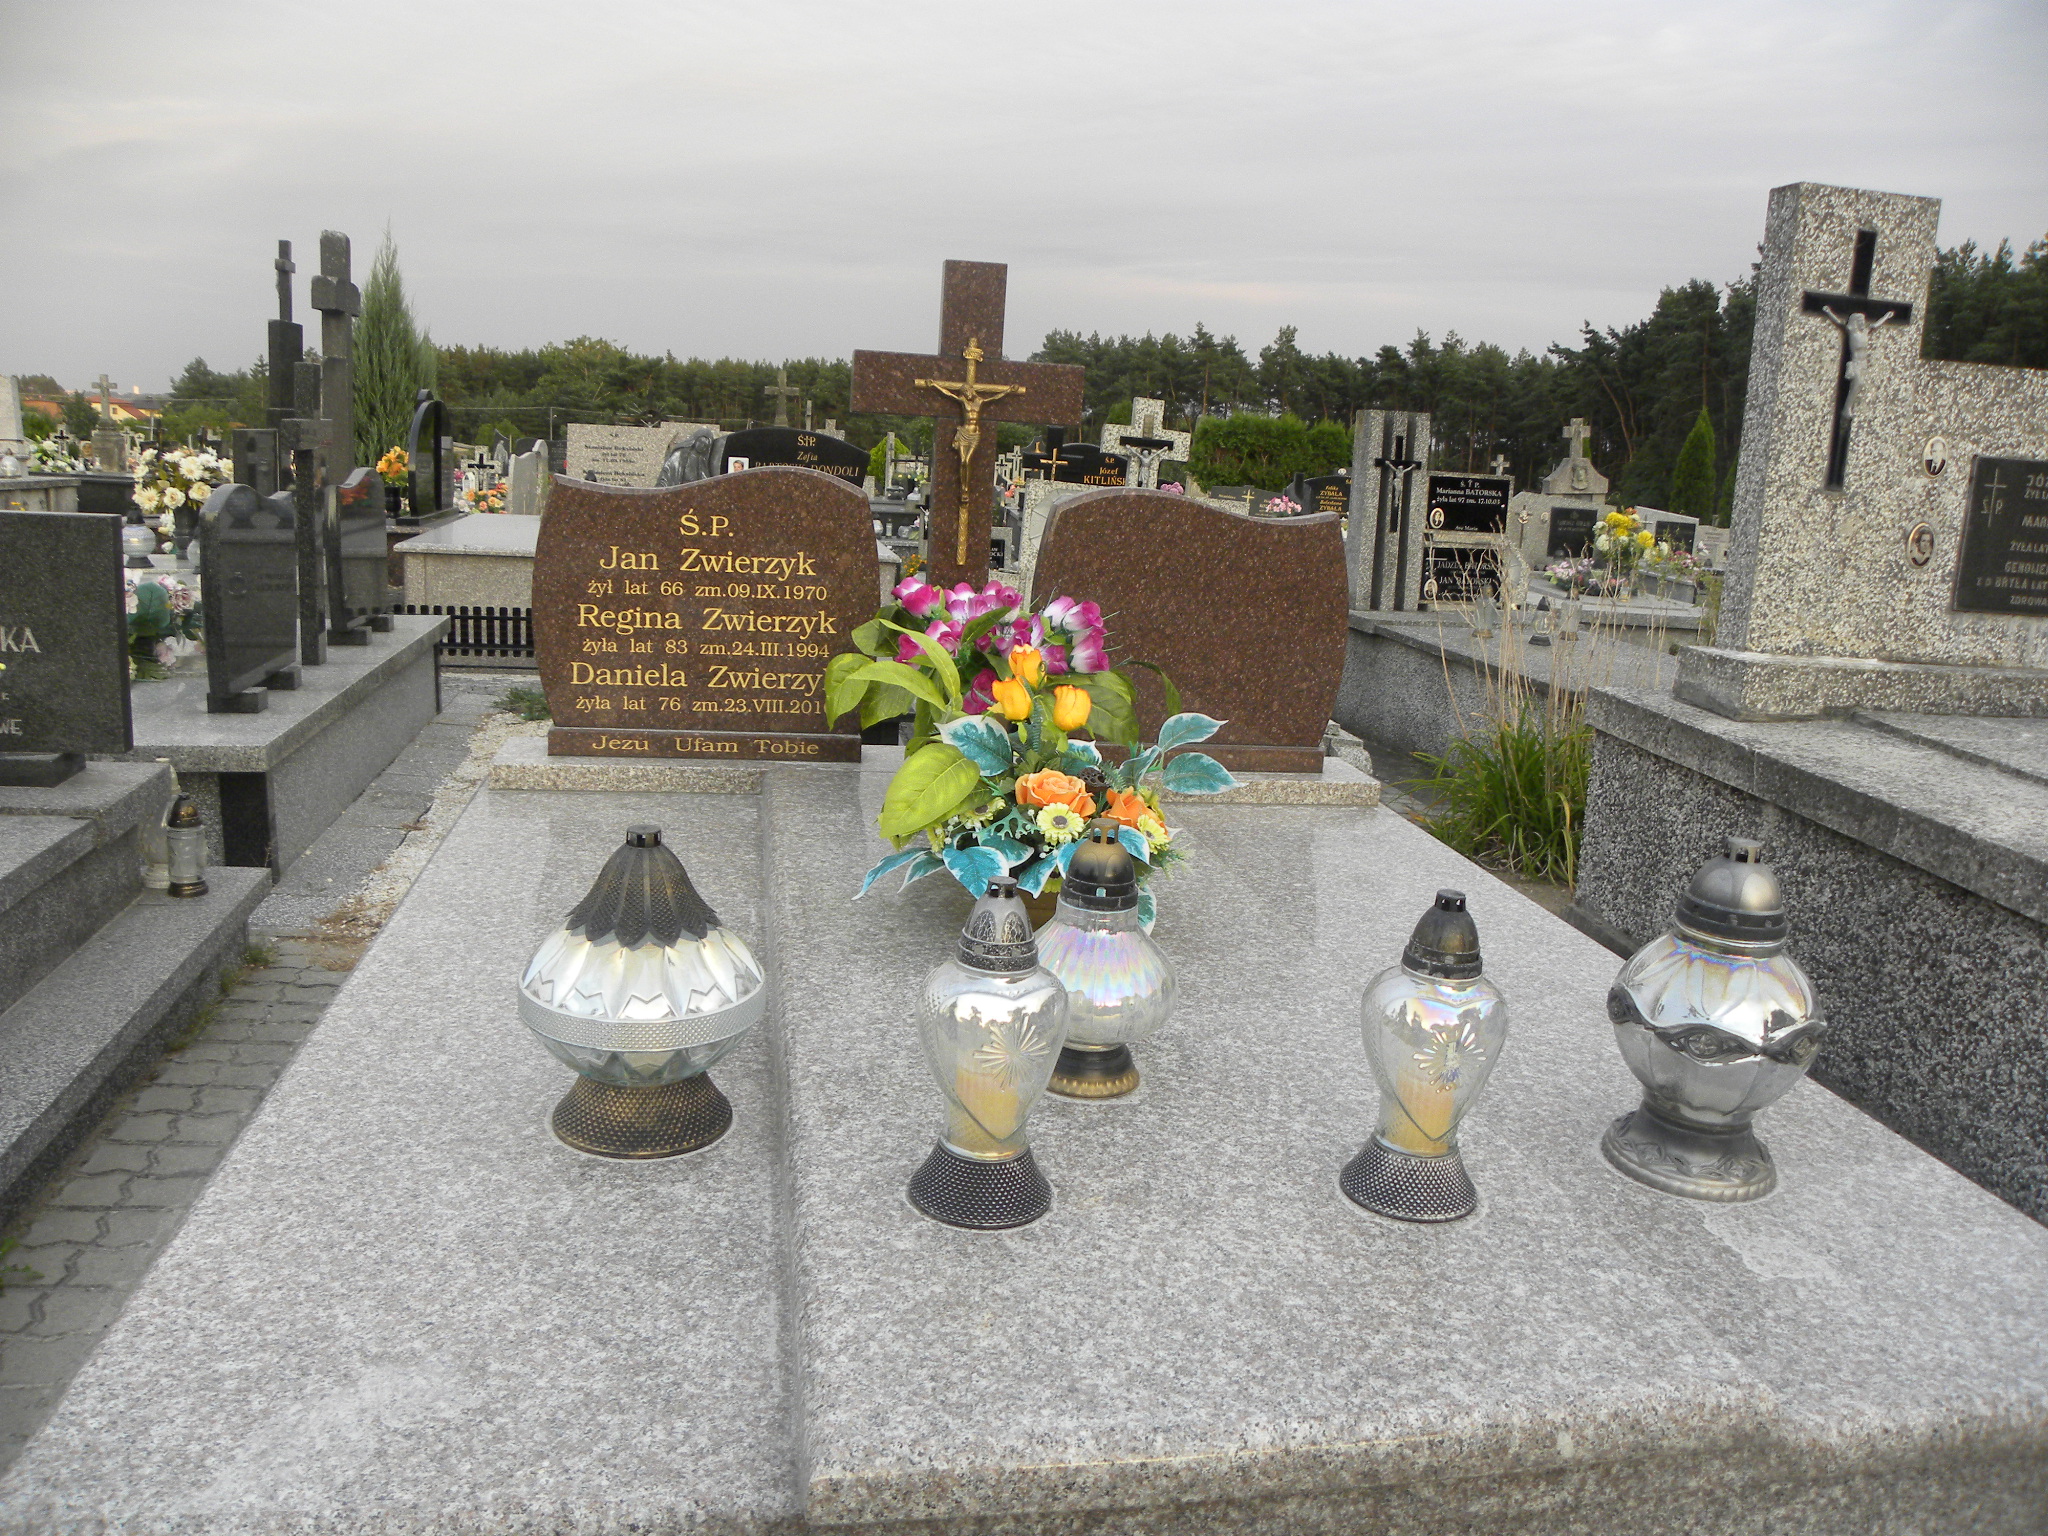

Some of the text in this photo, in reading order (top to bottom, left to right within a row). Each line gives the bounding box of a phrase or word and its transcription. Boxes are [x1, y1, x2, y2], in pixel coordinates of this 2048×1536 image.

[1465, 488, 1502, 497] BATORSKA
[680, 508, 734, 537] Ś.P.
[600, 545, 817, 582] Jan Zwierzyk
[587, 579, 613, 598] żył
[624, 580, 649, 595] lat
[660, 581, 684, 596] 66
[577, 603, 838, 640] Regina Zwierzyk
[582, 637, 618, 656] żyła
[629, 638, 654, 653] lat
[665, 639, 688, 654] 83
[570, 661, 826, 697] Daniela Zwierzy
[575, 695, 826, 714] żyła lat 76 zm.23.VIII.201
[592, 735, 820, 755] Jezu Ufam Tobie
